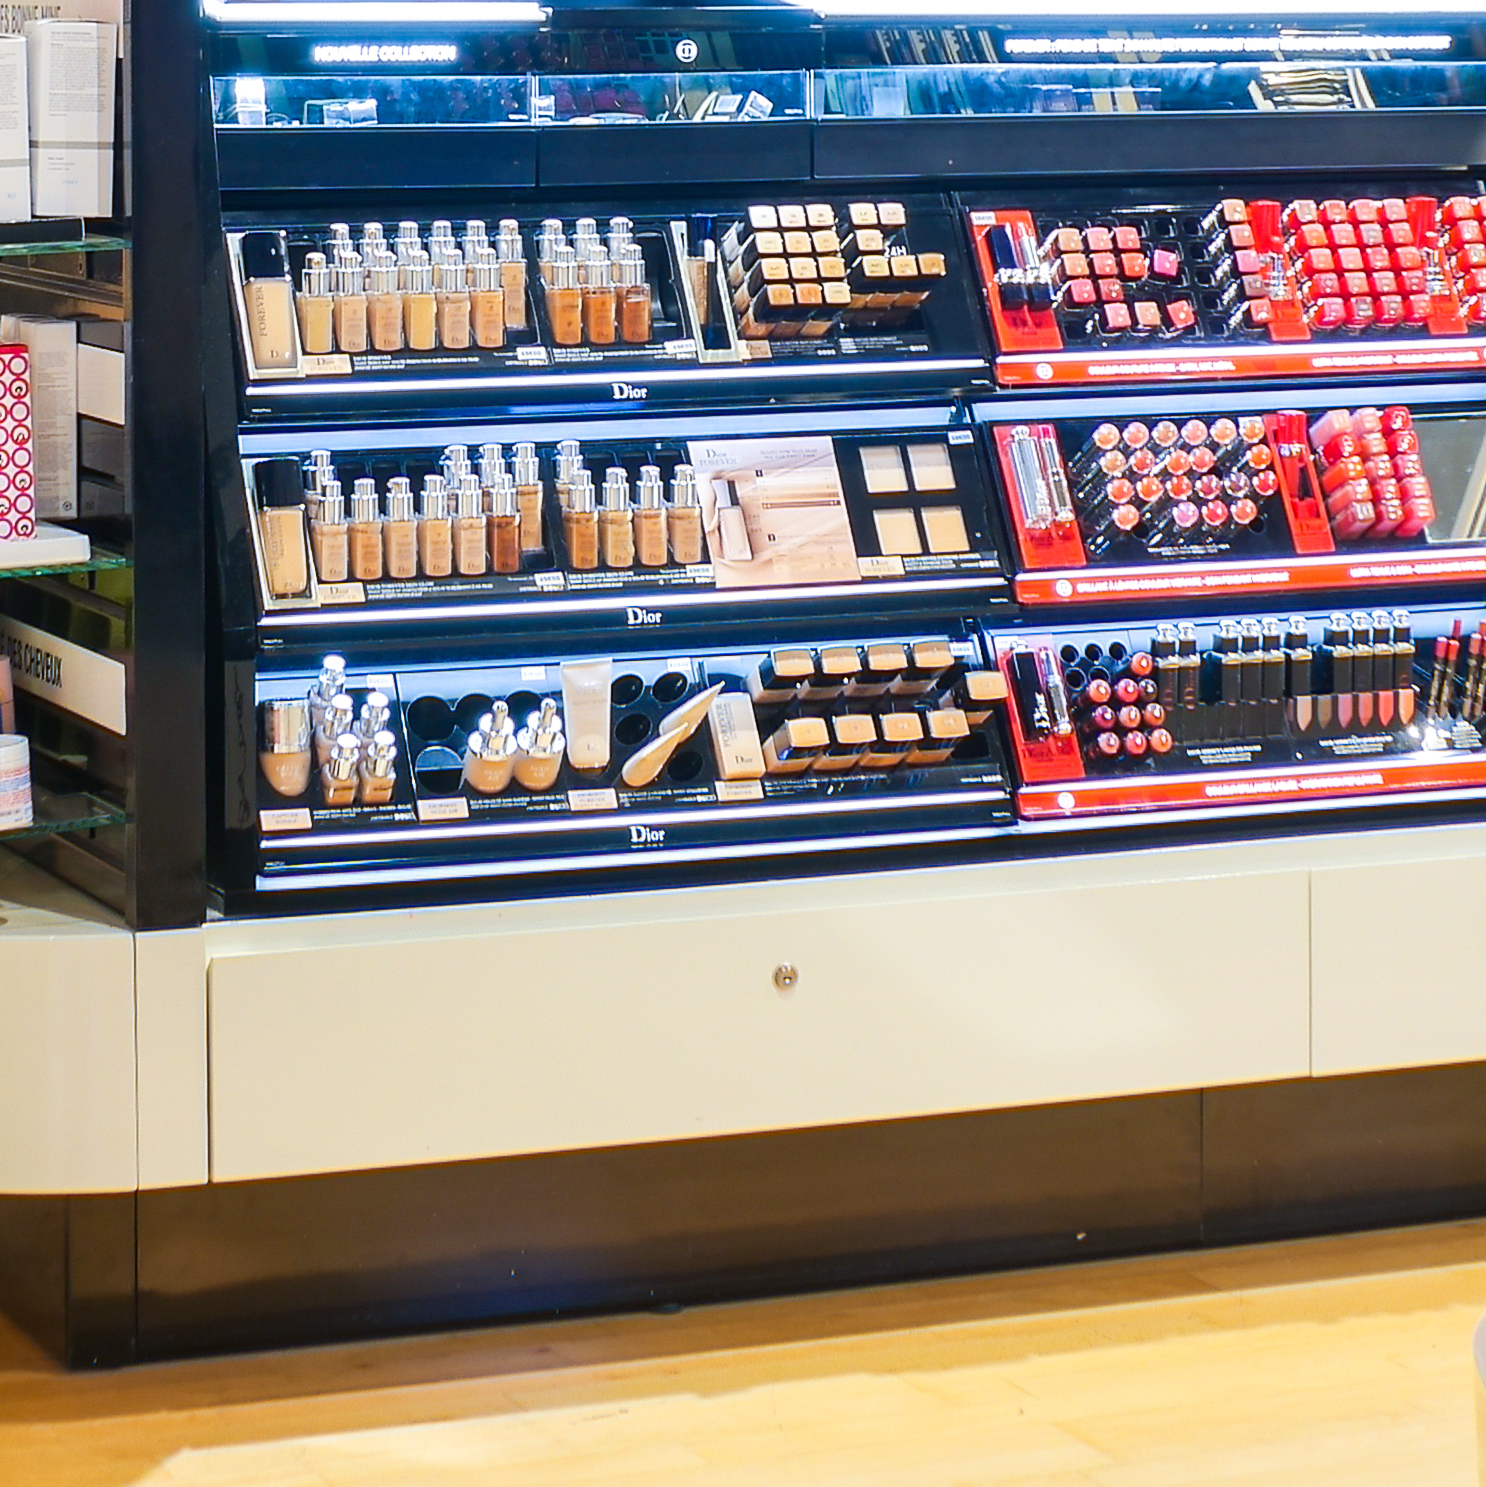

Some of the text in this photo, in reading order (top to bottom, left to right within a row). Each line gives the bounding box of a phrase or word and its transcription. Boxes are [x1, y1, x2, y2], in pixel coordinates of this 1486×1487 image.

[611, 383, 648, 400] Dior
[626, 607, 663, 625] Dior
[24, 643, 62, 689] CHEVEUX
[629, 826, 665, 843] Dior
